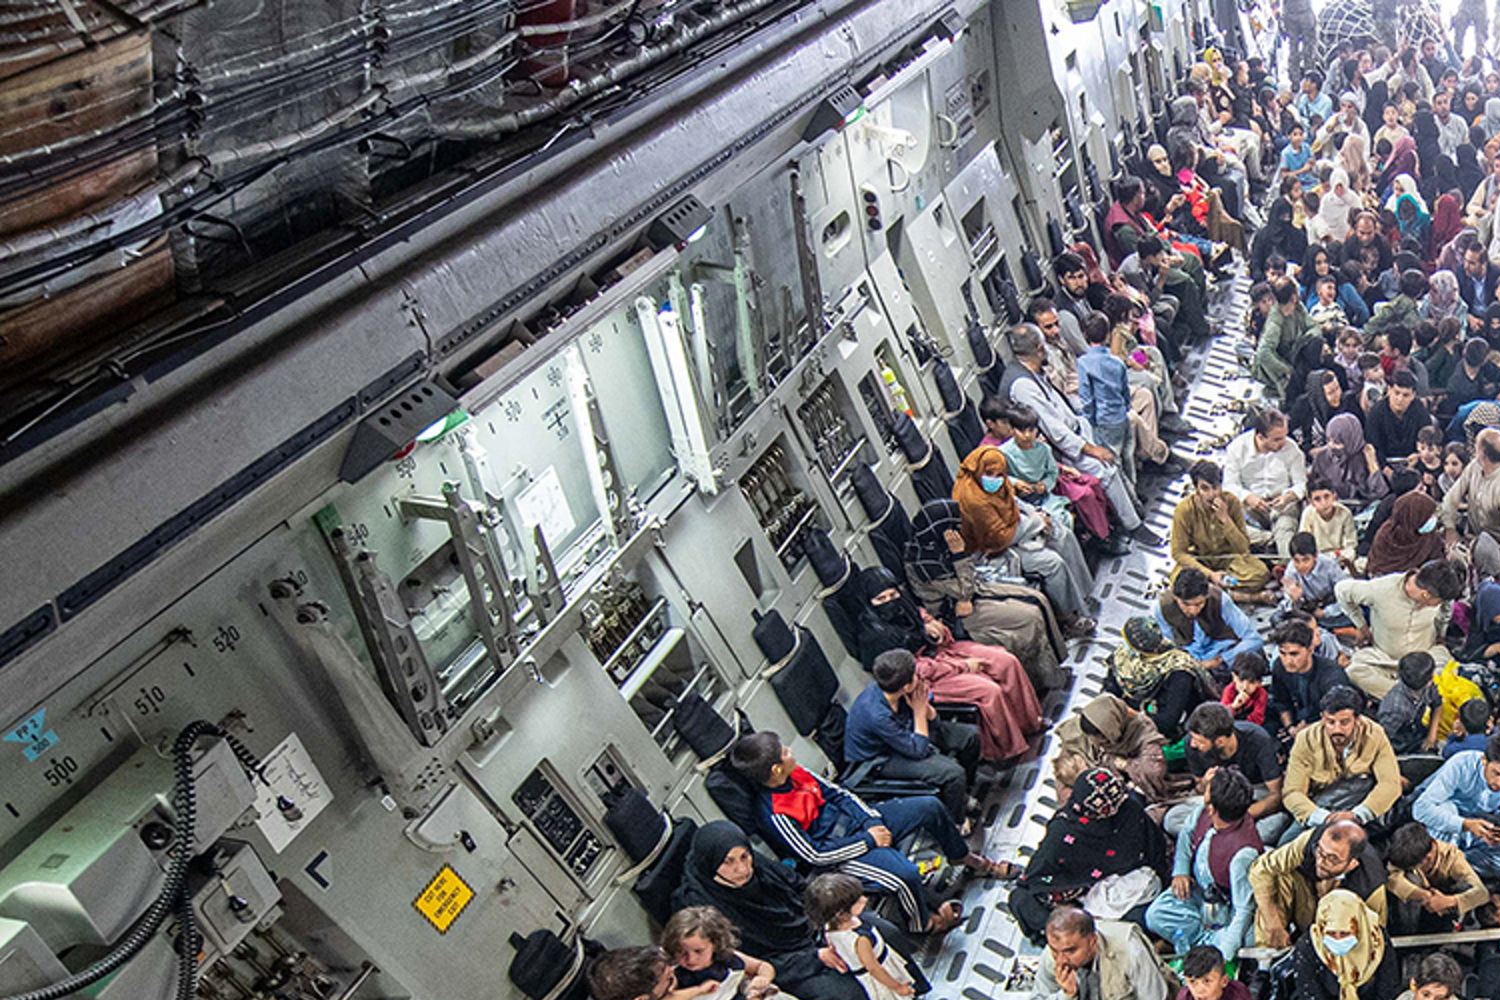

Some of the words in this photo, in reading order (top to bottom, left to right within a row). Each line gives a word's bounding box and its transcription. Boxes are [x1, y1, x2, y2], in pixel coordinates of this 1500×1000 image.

[212, 625, 241, 653] 520
[134, 686, 166, 716] 510
[44, 755, 78, 787] 500
